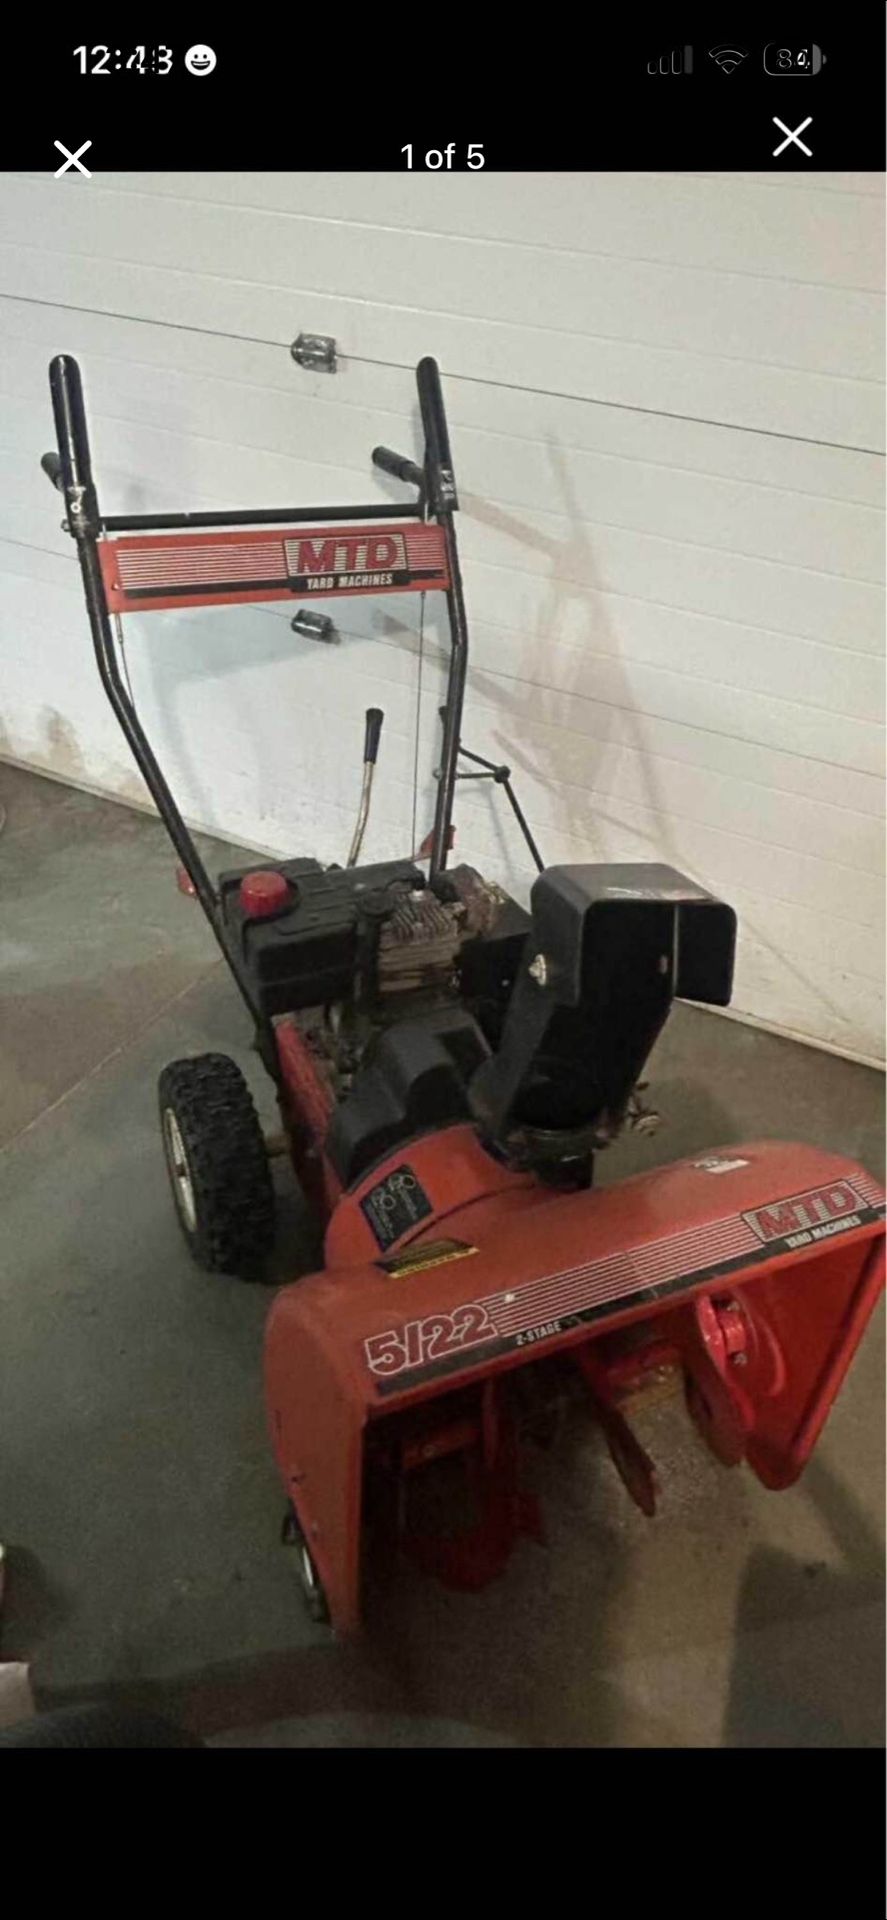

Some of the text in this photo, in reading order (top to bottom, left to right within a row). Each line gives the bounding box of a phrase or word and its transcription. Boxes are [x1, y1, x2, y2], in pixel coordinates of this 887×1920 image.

[299, 537, 398, 572] MTD
[306, 573, 393, 590] YARD MACHINES
[756, 1185, 857, 1240] MTD
[784, 1215, 862, 1249] YARD MACHINES
[364, 1303, 498, 1376] 5/22
[515, 1320, 562, 1346] 2-STAGE
